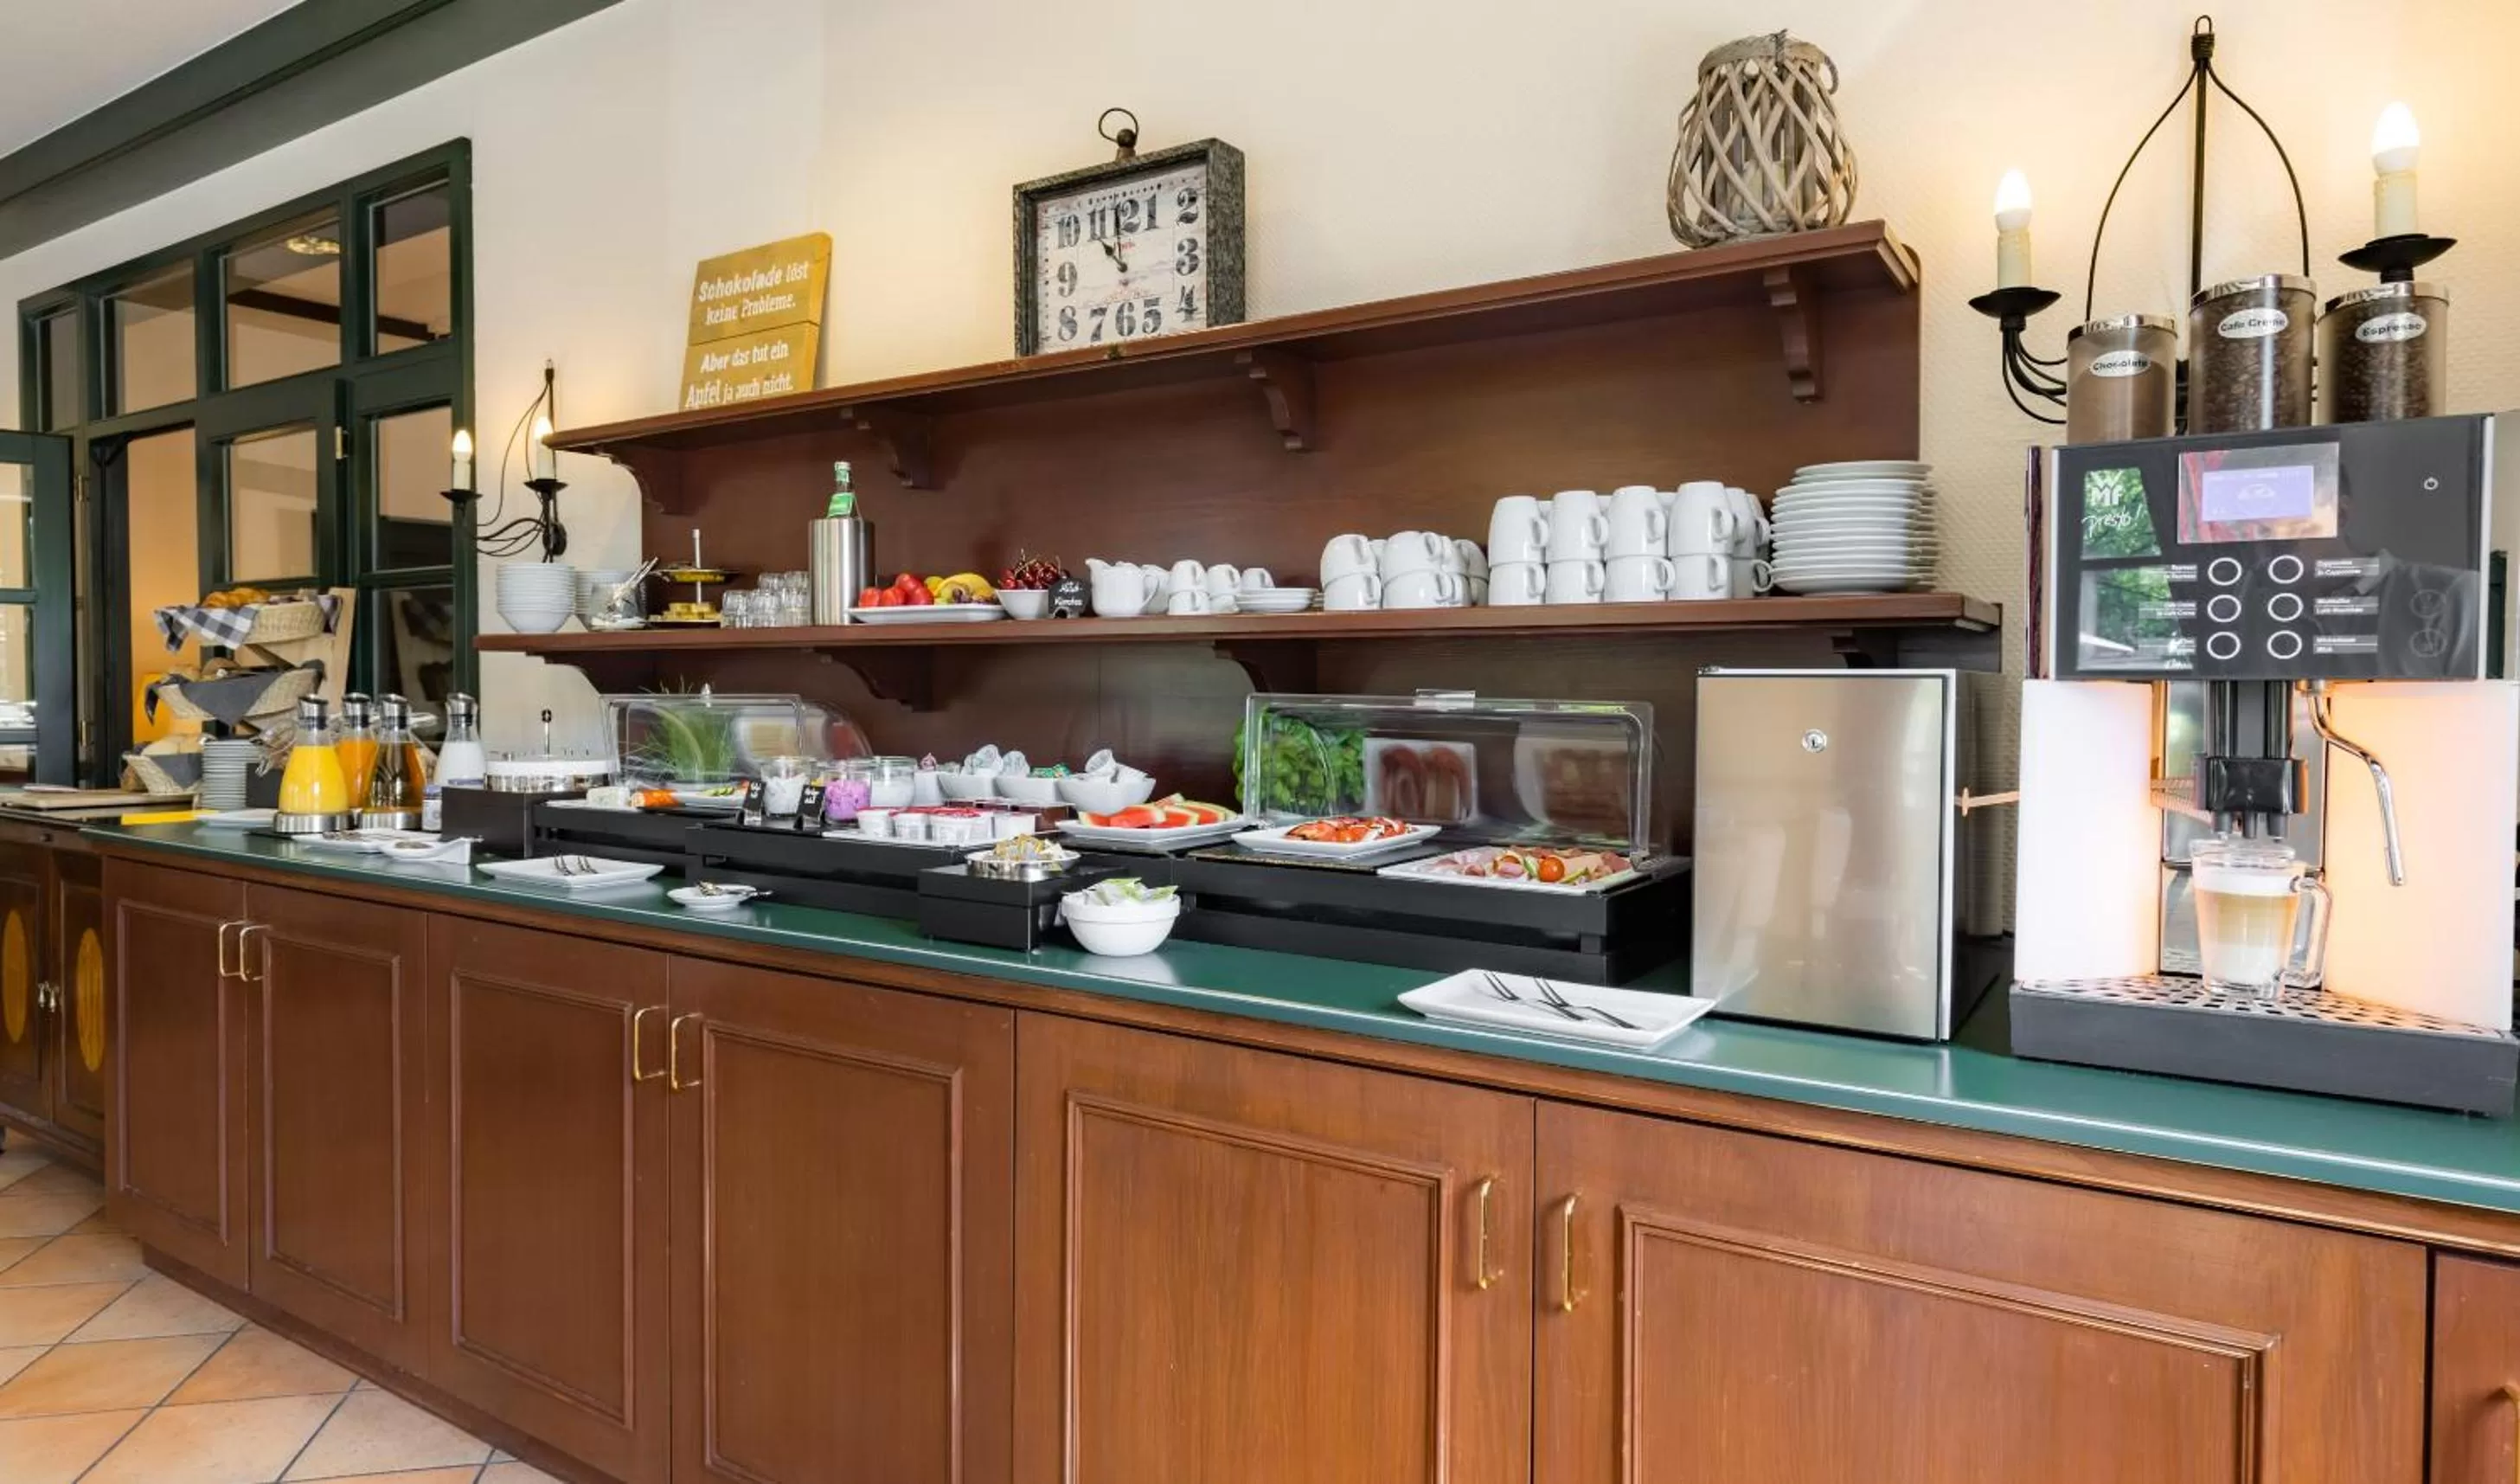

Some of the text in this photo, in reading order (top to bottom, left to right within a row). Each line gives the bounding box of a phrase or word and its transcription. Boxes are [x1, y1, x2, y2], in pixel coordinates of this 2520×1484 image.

[1055, 213, 1081, 250] 10
[1087, 206, 1108, 243] 11
[1144, 193, 1160, 231] 1
[1177, 187, 1199, 227] 2
[698, 260, 810, 303] Schokolade löst
[1057, 237, 1200, 299] 9 3
[704, 293, 797, 326] keine Probleme.
[1057, 297, 1162, 344] 8 7 6 5
[1175, 284, 1200, 323] 4
[2362, 322, 2422, 337] Espresso
[699, 339, 790, 375] Aber das tut ein
[2093, 357, 2149, 371] Chocolate
[683, 373, 794, 410] Apfel ja auch nicht.
